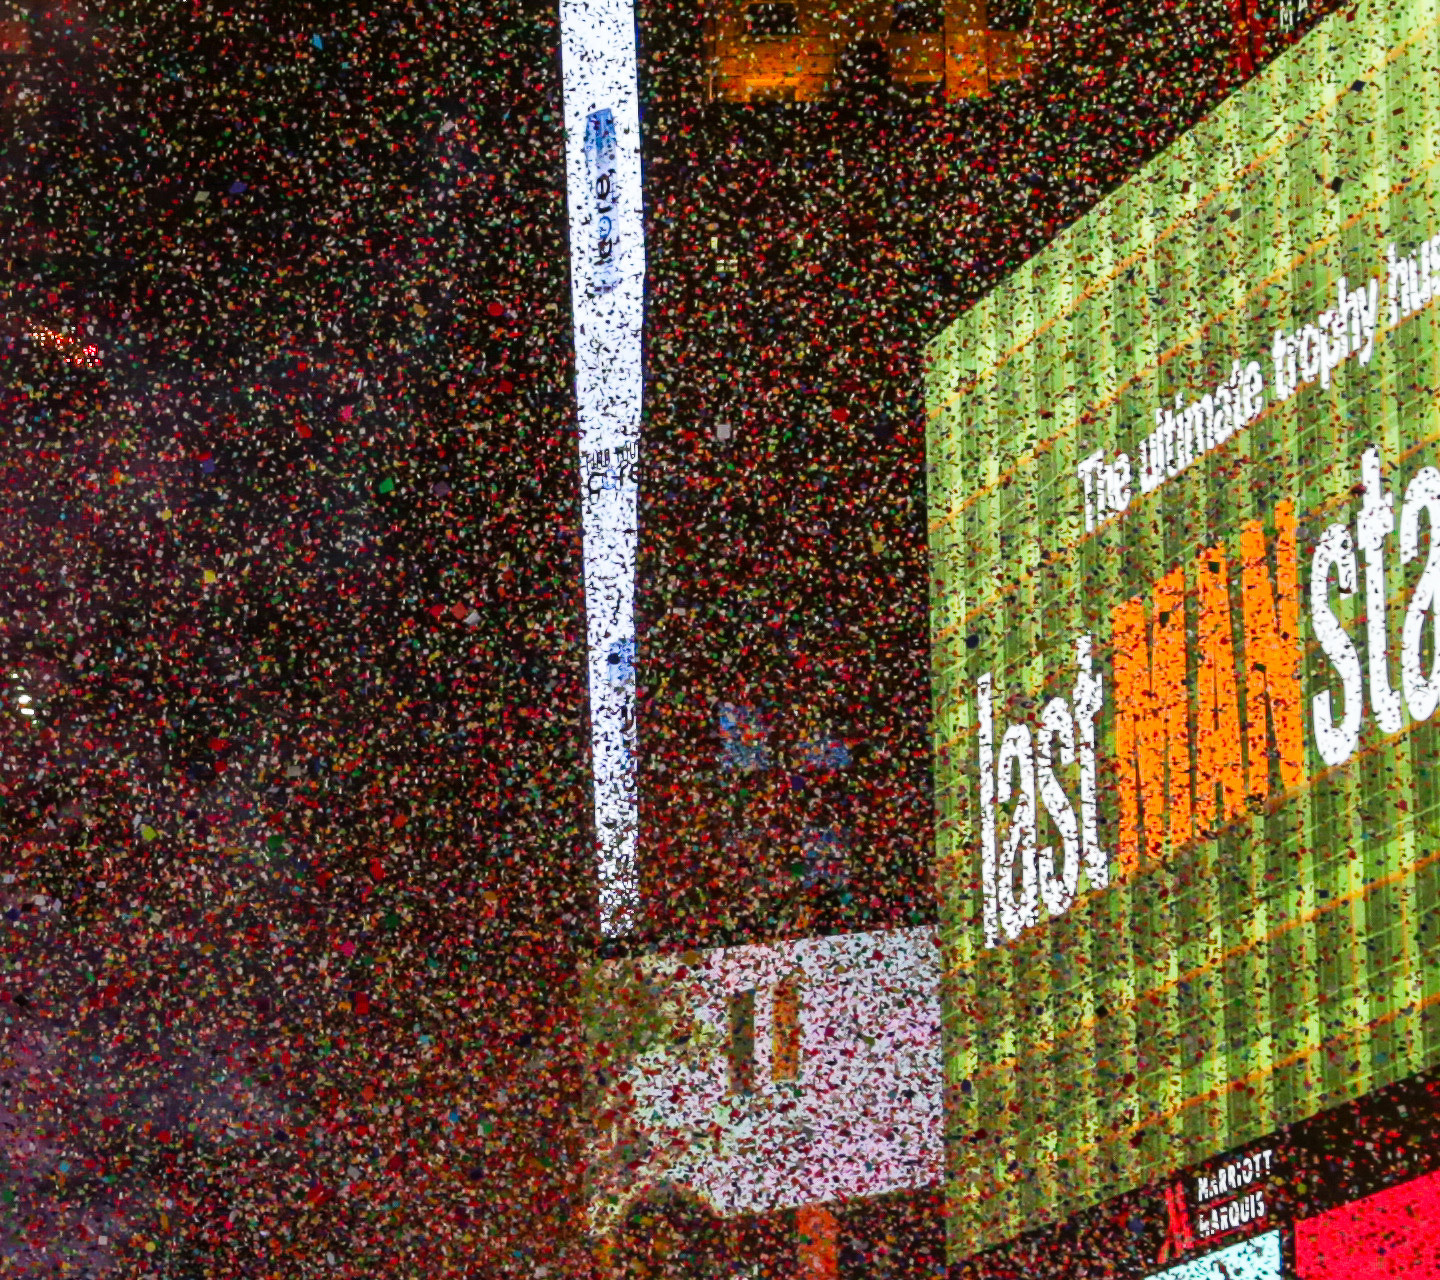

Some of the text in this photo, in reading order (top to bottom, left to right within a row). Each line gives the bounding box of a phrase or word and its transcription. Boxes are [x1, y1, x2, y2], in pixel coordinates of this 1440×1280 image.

[1077, 450, 1132, 534] The
[1139, 360, 1263, 495] ultimate
[1273, 276, 1378, 390] trophy
[975, 633, 1110, 950] last
[1111, 496, 1305, 879] MAN
[1198, 1149, 1273, 1202] MARRIOTT
[1199, 1191, 1266, 1238] MARQUIS
